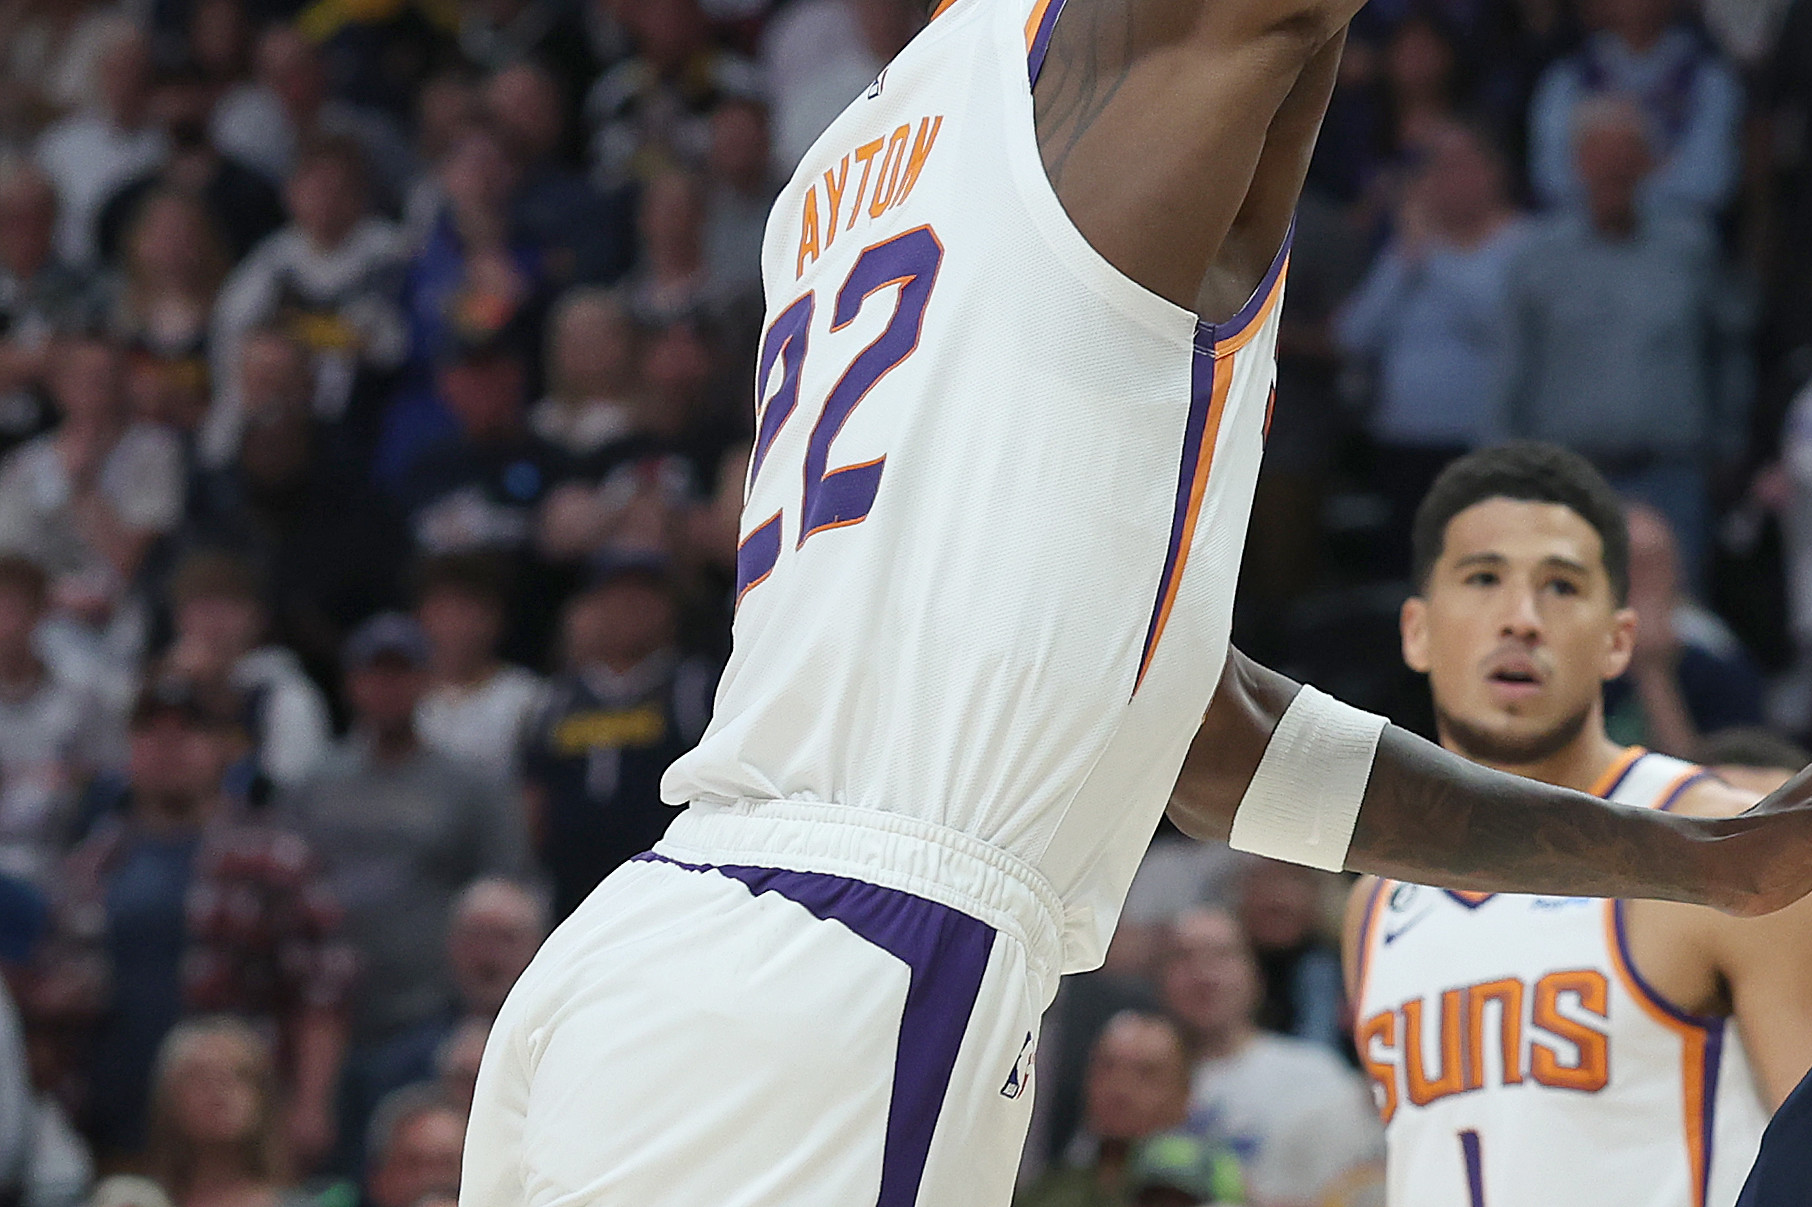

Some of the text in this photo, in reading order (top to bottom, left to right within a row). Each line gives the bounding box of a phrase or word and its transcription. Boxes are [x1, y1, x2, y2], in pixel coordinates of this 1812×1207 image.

[796, 115, 943, 280] AYTON
[735, 223, 945, 607] 22
[1356, 969, 1610, 1125] SUNS
